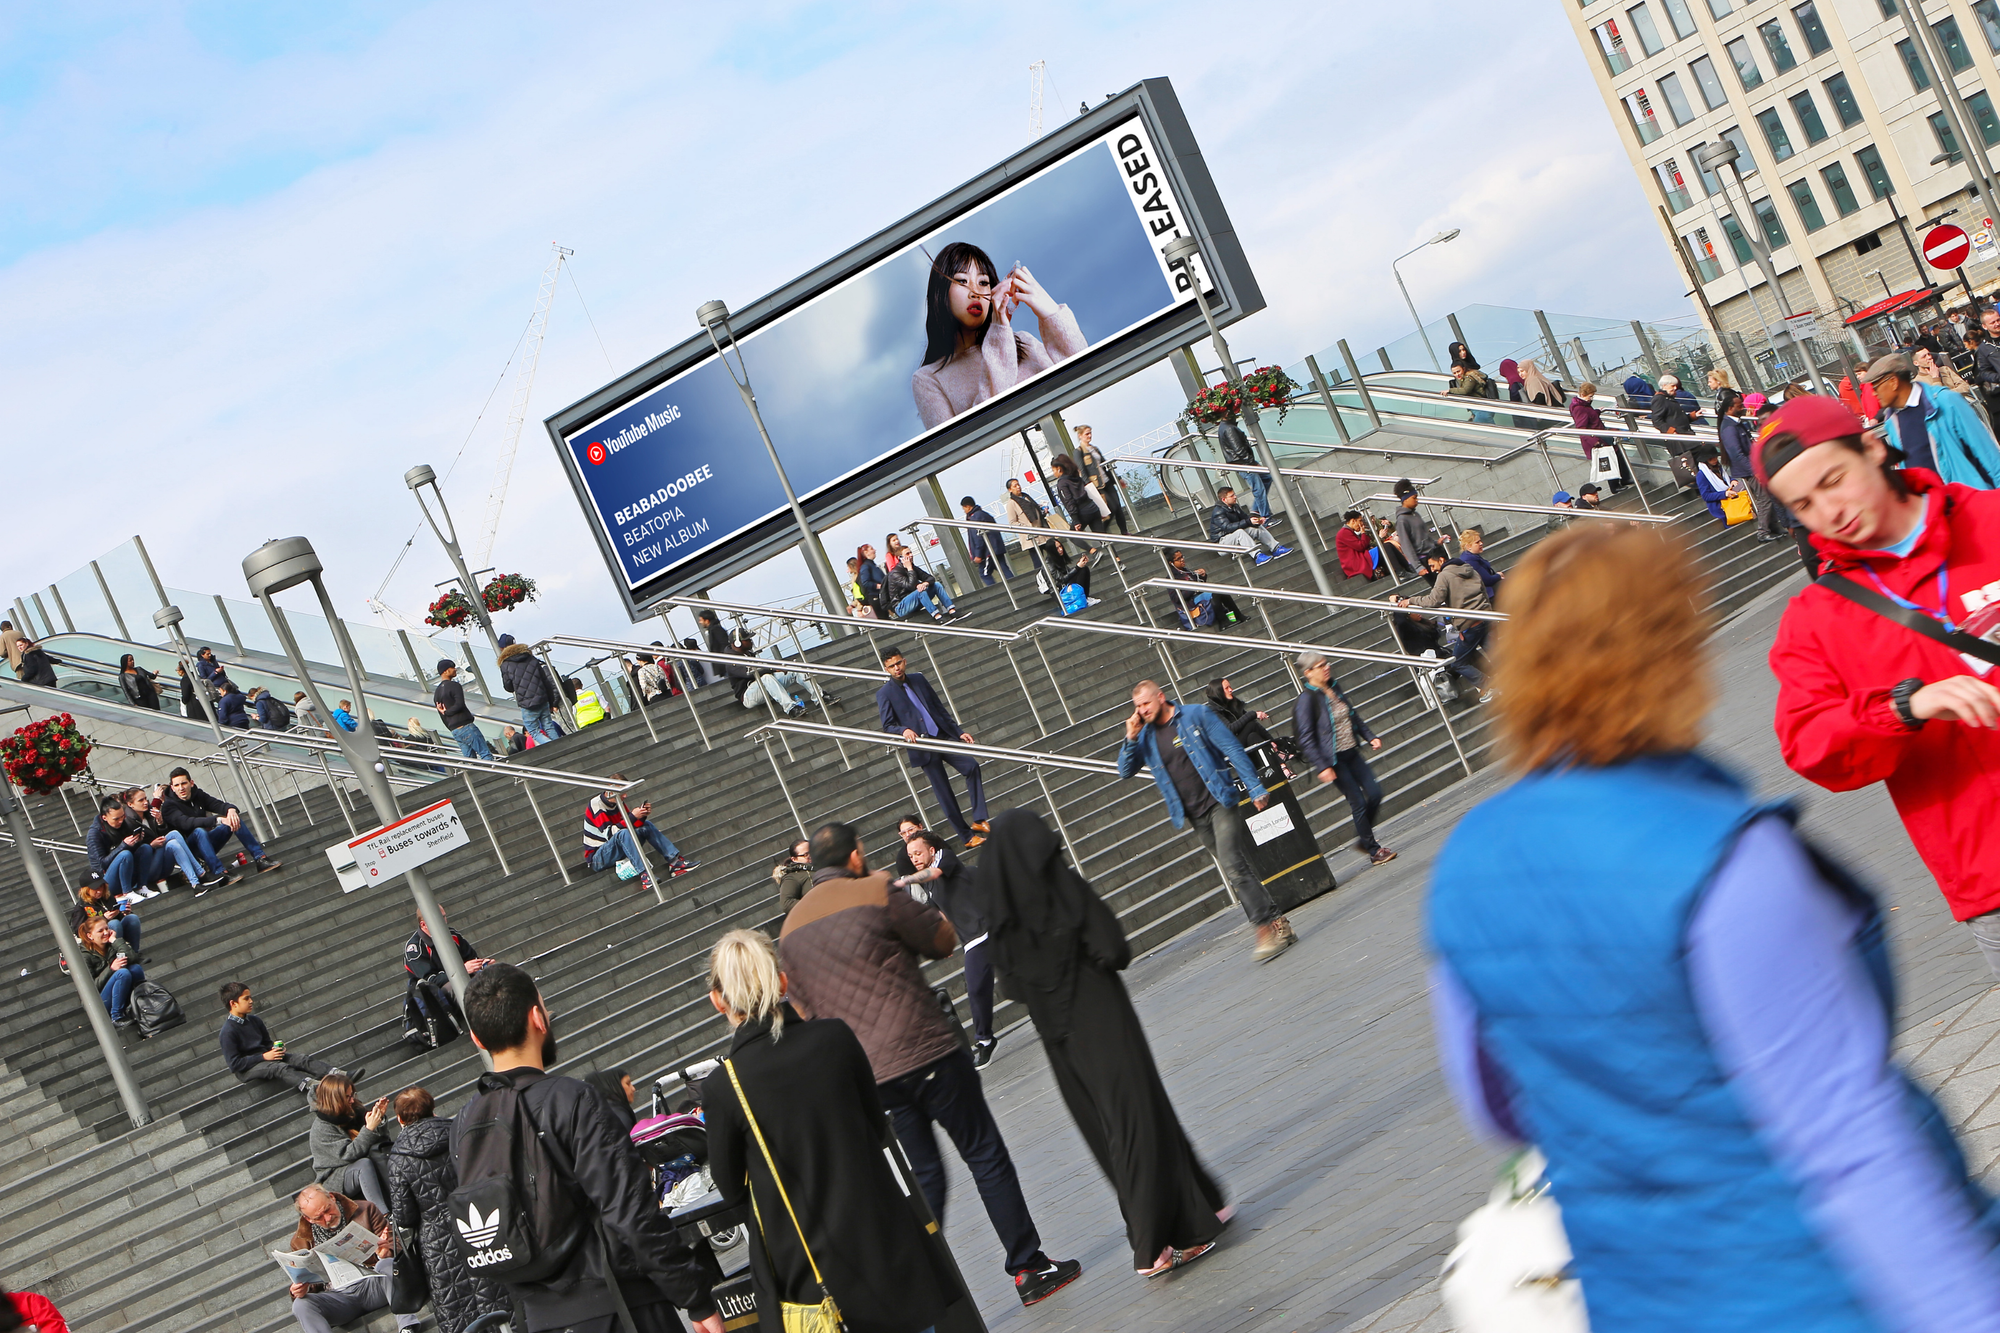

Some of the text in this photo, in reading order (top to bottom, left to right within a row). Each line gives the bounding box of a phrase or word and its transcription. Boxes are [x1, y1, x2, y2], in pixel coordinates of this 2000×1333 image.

[1117, 133, 1201, 293] REASED
[603, 404, 681, 455] YouTube Music
[614, 463, 714, 526] BEABADOOBEE
[623, 506, 685, 547] BEATOPIA
[632, 517, 710, 567] NEW ALBUM
[367, 812, 445, 851] TfL Rail replacement buses
[386, 821, 449, 855] Buses towards
[1271, 814, 1289, 826] London
[426, 831, 454, 849] Shenfield
[364, 860, 376, 868] Stop
[467, 1248, 513, 1269] adidas
[717, 1292, 757, 1319] Litter
